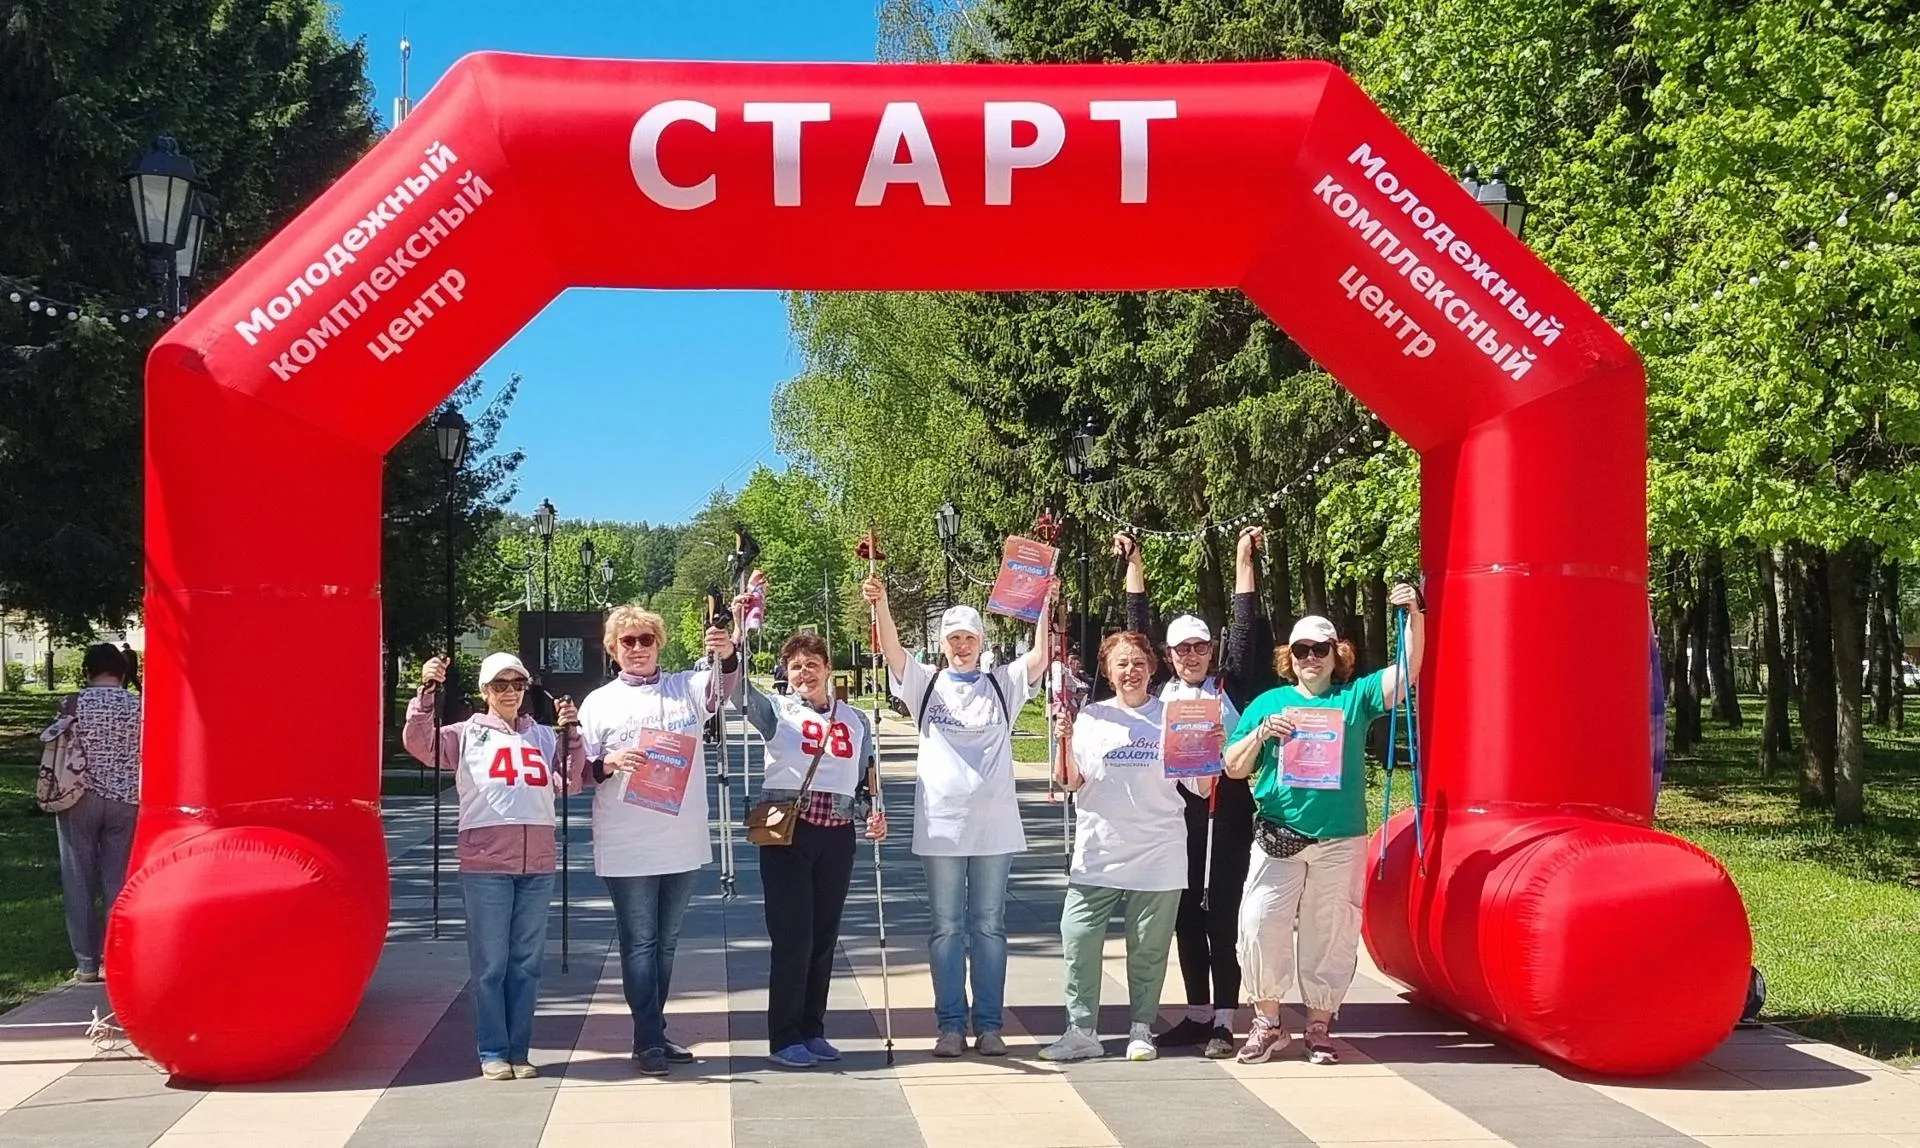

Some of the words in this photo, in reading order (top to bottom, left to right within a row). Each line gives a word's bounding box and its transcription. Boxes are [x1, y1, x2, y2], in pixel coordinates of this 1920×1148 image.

[629, 99, 1178, 211] СТАРТ
[234, 141, 458, 346] Молодежный
[268, 170, 494, 382] комплексный
[1313, 174, 1537, 381] комплексный
[1347, 143, 1564, 347] Молодежный
[367, 268, 466, 362] центр
[1338, 265, 1437, 358] центр
[489, 747, 549, 787] 45
[801, 719, 854, 759] 98
